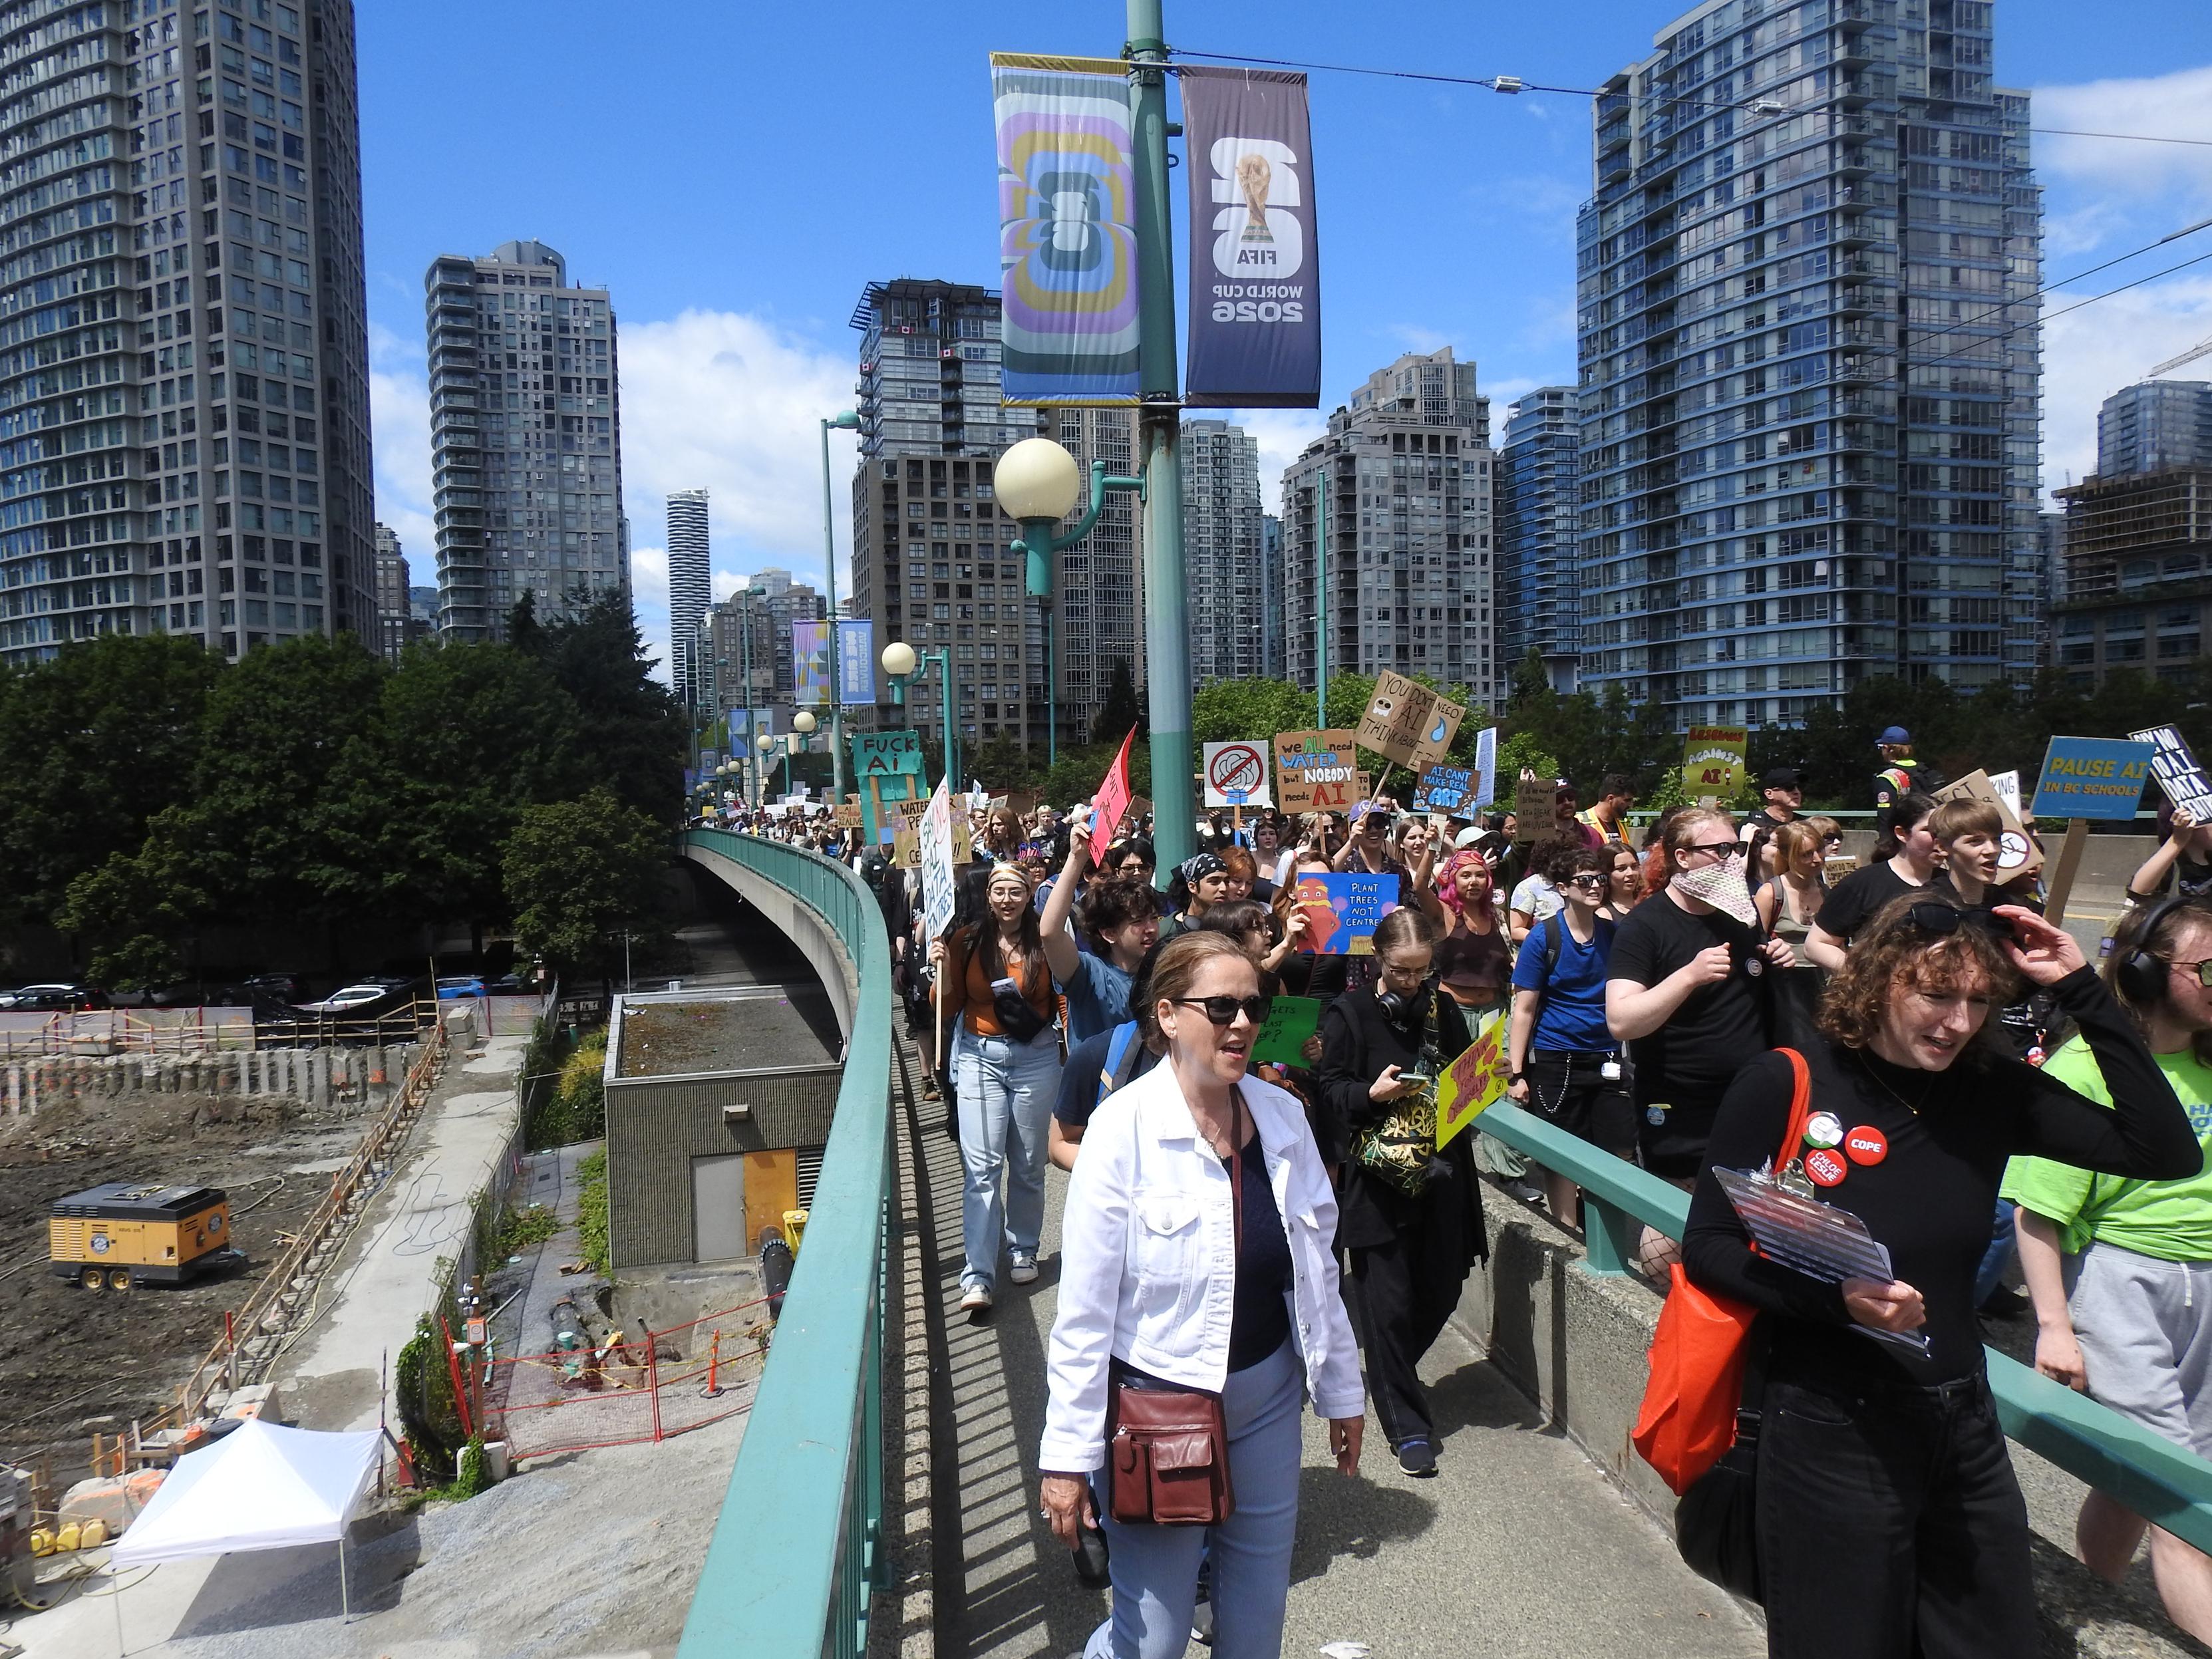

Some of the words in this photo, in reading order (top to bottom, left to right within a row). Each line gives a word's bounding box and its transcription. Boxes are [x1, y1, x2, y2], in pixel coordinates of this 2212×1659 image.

[1384, 675, 1410, 696] YOU
[1434, 702, 1459, 718] NEED
[1393, 704, 1426, 730] AI
[1363, 718, 1396, 744] THINK
[1397, 734, 1424, 748] ABOUT
[2153, 728, 2180, 751] NO
[864, 737, 915, 752] FUCK
[1282, 743, 1302, 753] we
[1303, 735, 1329, 754] ALL
[1329, 740, 1352, 751] need
[1279, 752, 1338, 769] WATER
[1688, 748, 1742, 766] AGAINST
[1283, 774, 1299, 784] but
[1304, 766, 1353, 784] NOBODY
[1430, 766, 1444, 776] AI
[2049, 757, 2117, 778] PAUSE
[2120, 762, 2148, 778] AI
[1424, 775, 1446, 786] MAKE
[1448, 779, 1470, 792] REAL
[2044, 782, 2060, 793] IN
[2063, 783, 2080, 794] BC
[2083, 784, 2140, 796] SCHOOLS
[2161, 774, 2209, 801] DATA
[1285, 792, 1310, 802] needs
[1428, 787, 1463, 808] ART
[923, 818, 934, 850] SAY
[933, 790, 948, 840] NO
[925, 859, 947, 913] DATA
[1352, 883, 1378, 893] PLANT
[1350, 895, 1378, 904] TREES
[1351, 907, 1374, 916] NOT
[1346, 918, 1383, 927] CENTRE
[1456, 1041, 1487, 1078] THINK
[1851, 1139, 1882, 1153] COPE
[1809, 1157, 1837, 1182] LESLIE
[1815, 1151, 1842, 1176] CHLOE
